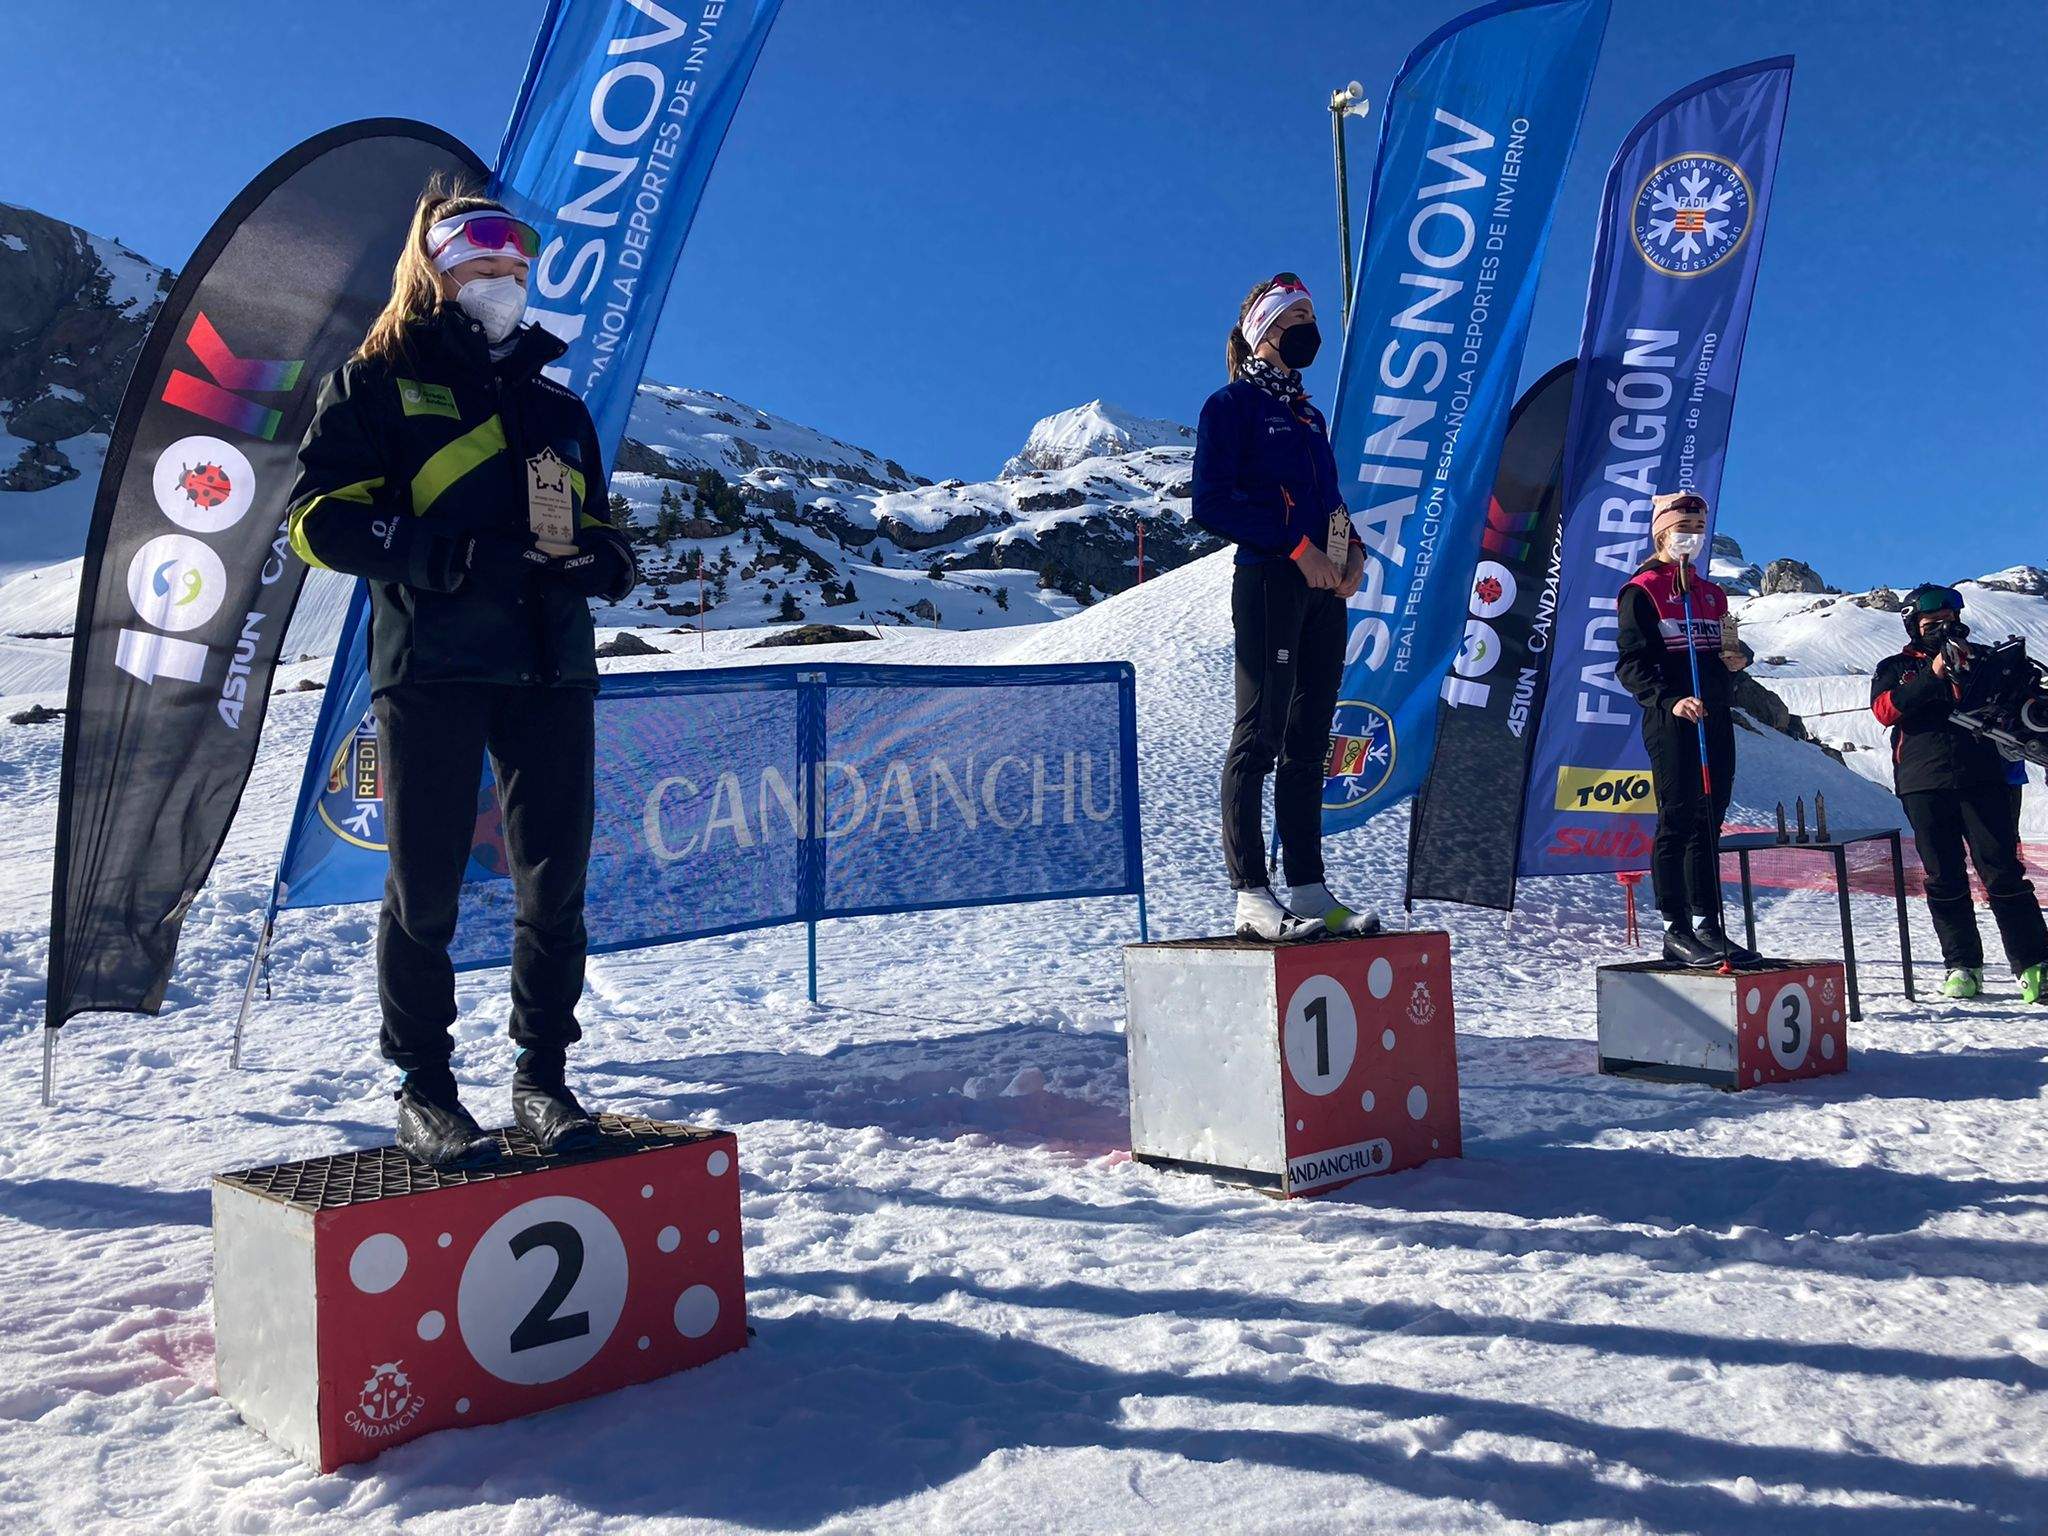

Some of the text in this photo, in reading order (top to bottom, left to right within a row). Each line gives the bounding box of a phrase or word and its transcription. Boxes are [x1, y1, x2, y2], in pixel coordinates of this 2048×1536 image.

[618, 122, 682, 270] DEPORTES
[667, 79, 696, 117] DE
[683, 0, 727, 71] INVIE
[1679, 198, 1706, 208] FADI
[1701, 160, 1748, 208] ARAGONESA
[1636, 225, 1742, 271] DEPORTES DE INVIERNO
[1344, 107, 1496, 672] SPAINSNOW
[1393, 118, 1530, 673] REAL FEDERACIÓN ESPAÑOLA DEPORTES DE INVIERNO
[1688, 332, 1718, 402] Invierno
[1594, 328, 1680, 576] ARAGÓN
[1686, 408, 1701, 429] de
[217, 611, 267, 729] ASTUN
[1507, 667, 1540, 738] ASTUN
[358, 741, 376, 797] RFEDI
[1576, 774, 1651, 808] TOKO
[642, 748, 1118, 862] CANDANCHU
[1303, 996, 1331, 1077] 1
[1781, 994, 1801, 1054] 3
[508, 1220, 591, 1354] 2
[344, 1395, 426, 1438] CANDANCHU
